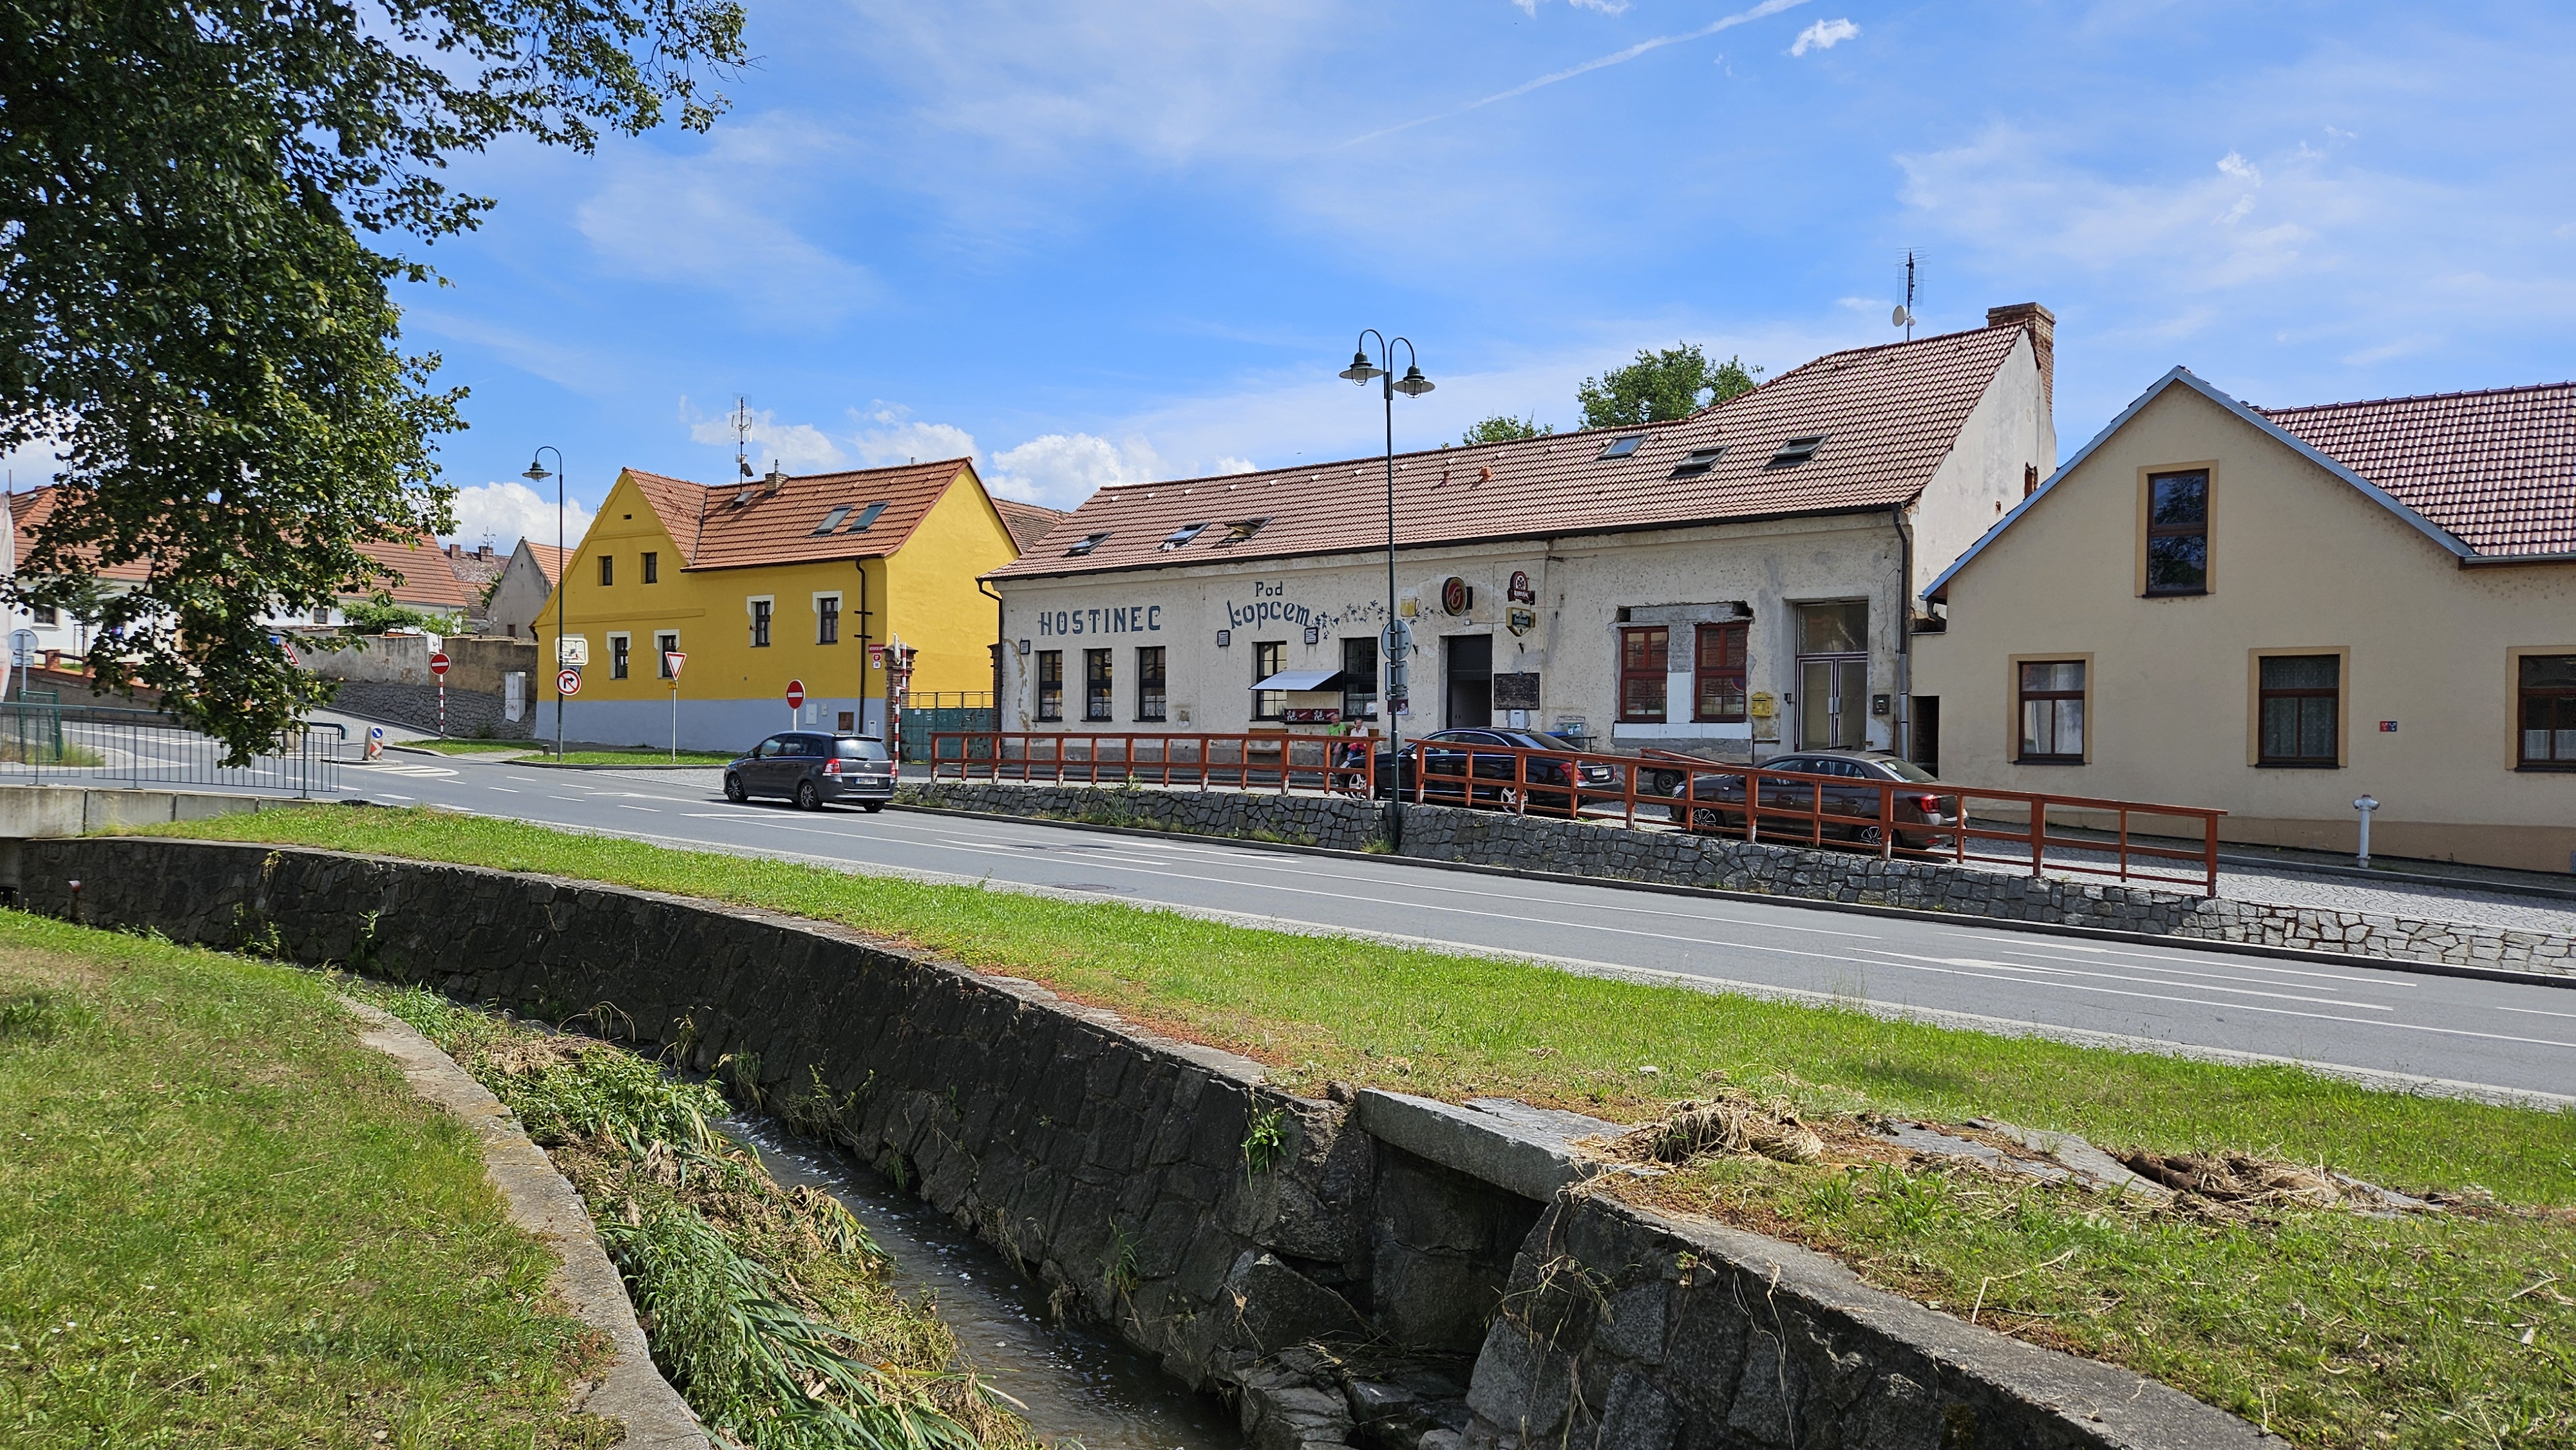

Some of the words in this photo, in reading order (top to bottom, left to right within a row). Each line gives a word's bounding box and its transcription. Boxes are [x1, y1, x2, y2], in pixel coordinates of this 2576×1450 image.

[1255, 580, 1283, 597] Pod
[1037, 605, 1161, 636] HOSTINEC
[1227, 599, 1314, 631] kopcem
